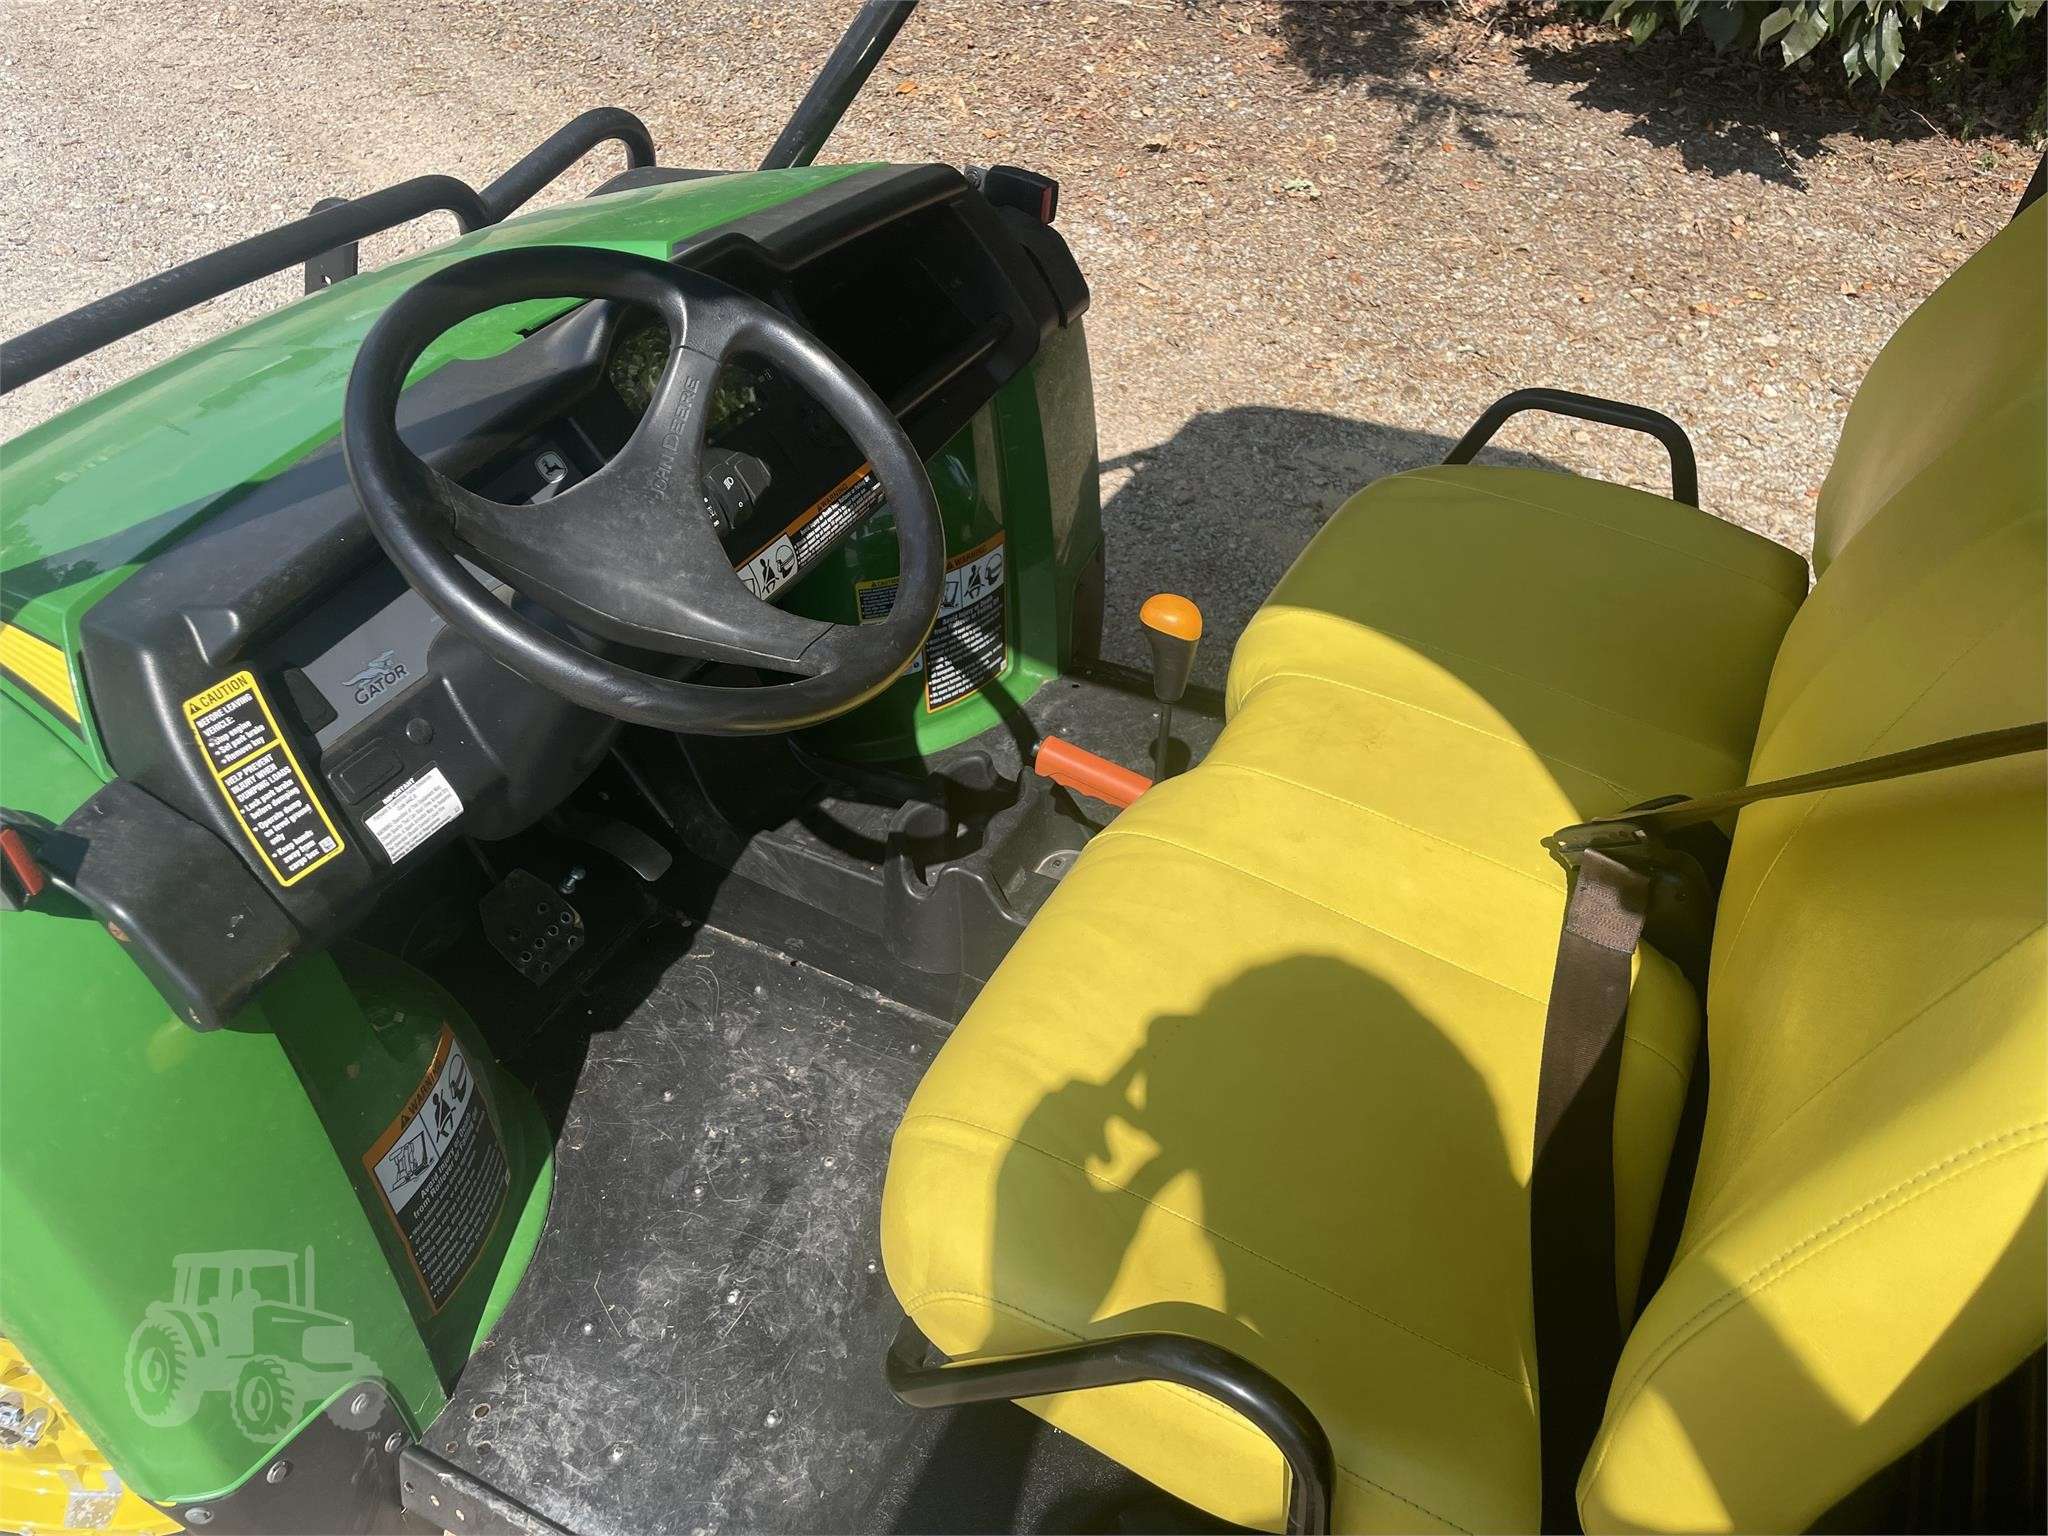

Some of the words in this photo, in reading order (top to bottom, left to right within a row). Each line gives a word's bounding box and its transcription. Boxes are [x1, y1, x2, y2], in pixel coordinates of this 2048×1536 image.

[662, 376, 700, 451] DEERE
[200, 675, 248, 707] CAUTION
[354, 664, 408, 705] GATOR
[195, 708, 226, 728] BEFORE
[222, 693, 253, 714] LEAVING
[228, 720, 252, 737] engine
[224, 771, 244, 787] HELP
[242, 753, 274, 776] PREVENT
[236, 778, 271, 803] DUMPING
[267, 765, 292, 784] LOADS
[255, 762, 278, 780] WHEN
[381, 777, 416, 805] IMPORTANT
[413, 1197, 431, 1219] from
[429, 1160, 456, 1198] Rollover
[420, 1171, 439, 1199] Avoid
[438, 1147, 456, 1173] Injury
